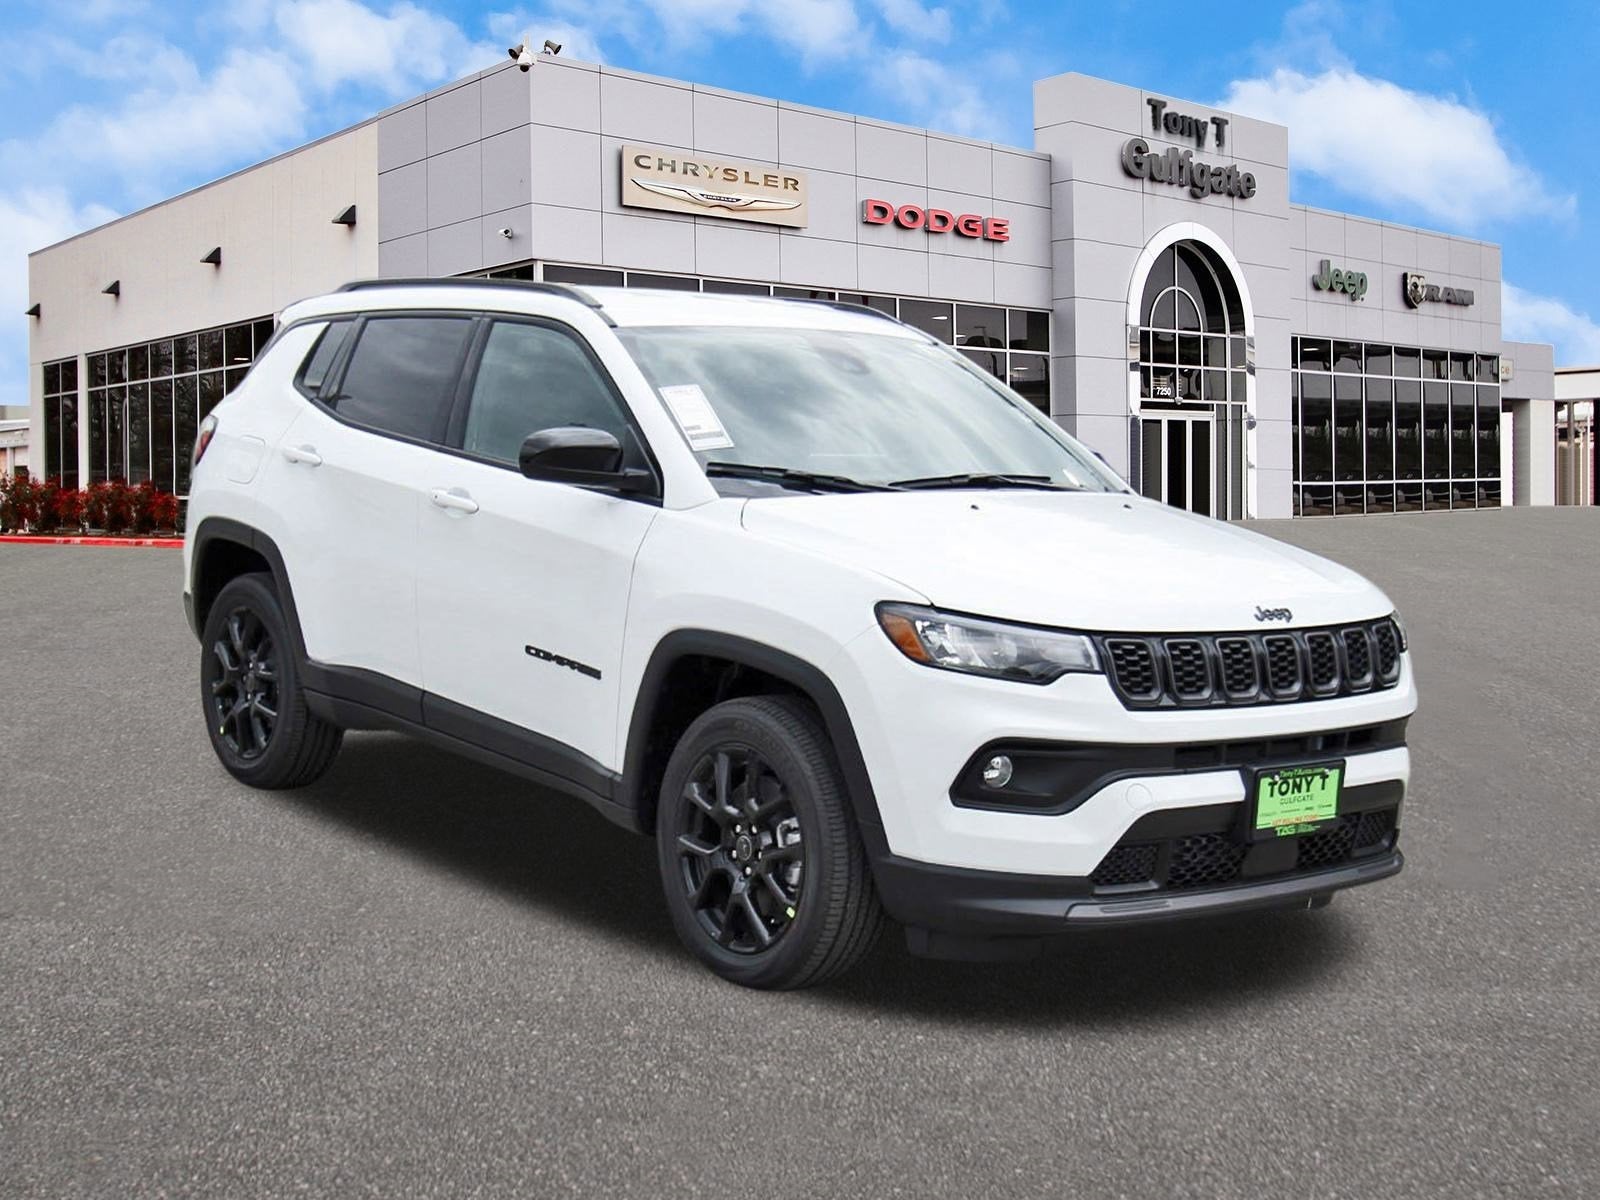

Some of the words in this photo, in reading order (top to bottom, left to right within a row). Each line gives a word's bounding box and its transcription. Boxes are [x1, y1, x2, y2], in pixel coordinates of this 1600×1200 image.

[1146, 97, 1209, 148] Tony
[1210, 116, 1229, 148] T
[633, 154, 800, 191] CHRYSLER
[1121, 137, 1257, 199] Gulfgate
[862, 198, 1010, 243] DODGE
[1312, 259, 1368, 302] Jeep
[1424, 283, 1475, 307] RAM
[1156, 386, 1172, 396] 7250
[1254, 605, 1293, 623] Jeep
[1267, 774, 1315, 798] TONY
[1319, 773, 1330, 791] T
